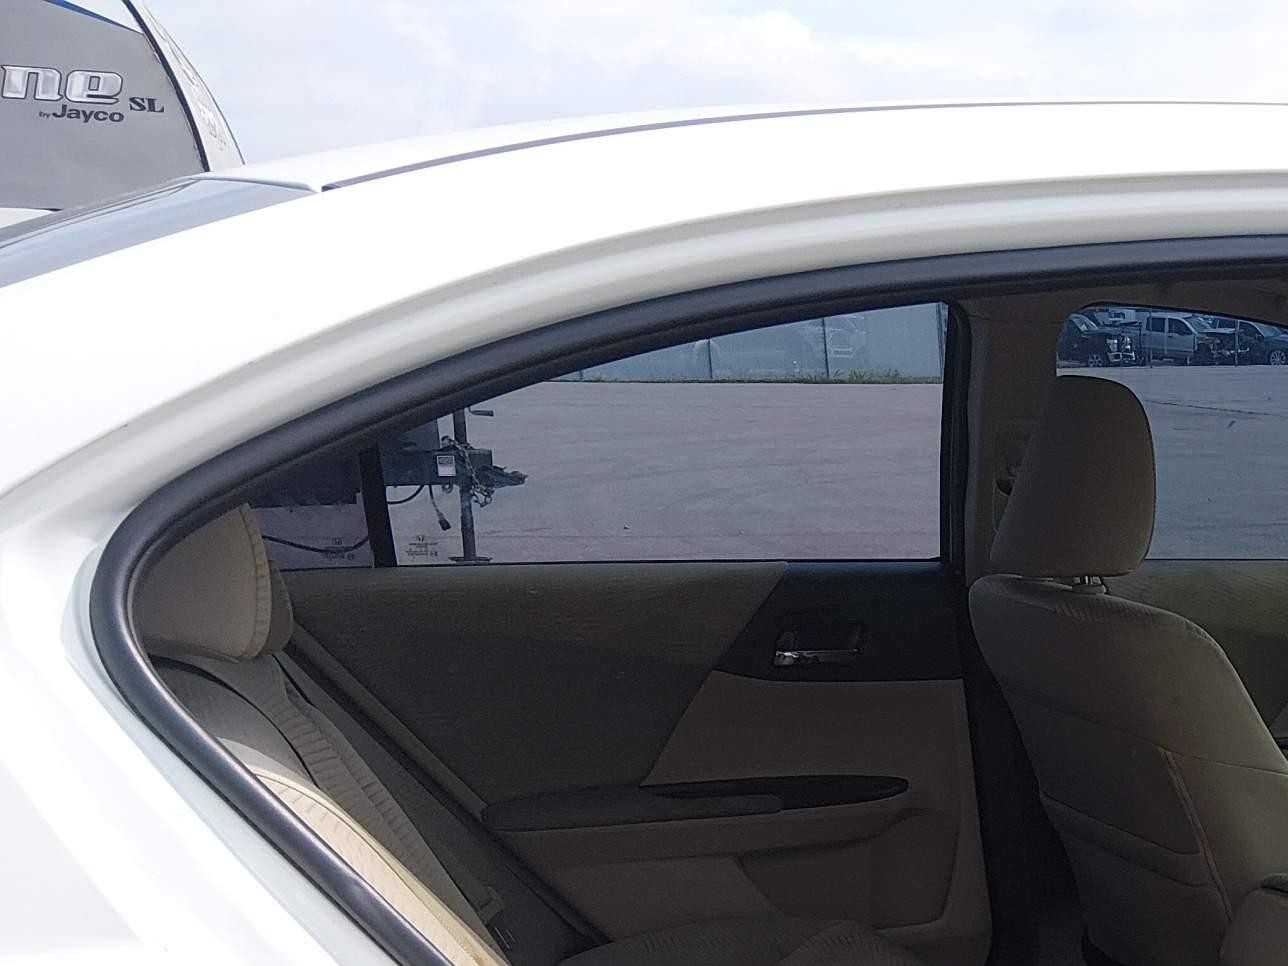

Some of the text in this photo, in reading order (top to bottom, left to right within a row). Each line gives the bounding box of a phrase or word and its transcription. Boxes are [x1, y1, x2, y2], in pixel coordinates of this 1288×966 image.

[39, 104, 124, 123] by Jayco
[129, 97, 165, 113] SL
